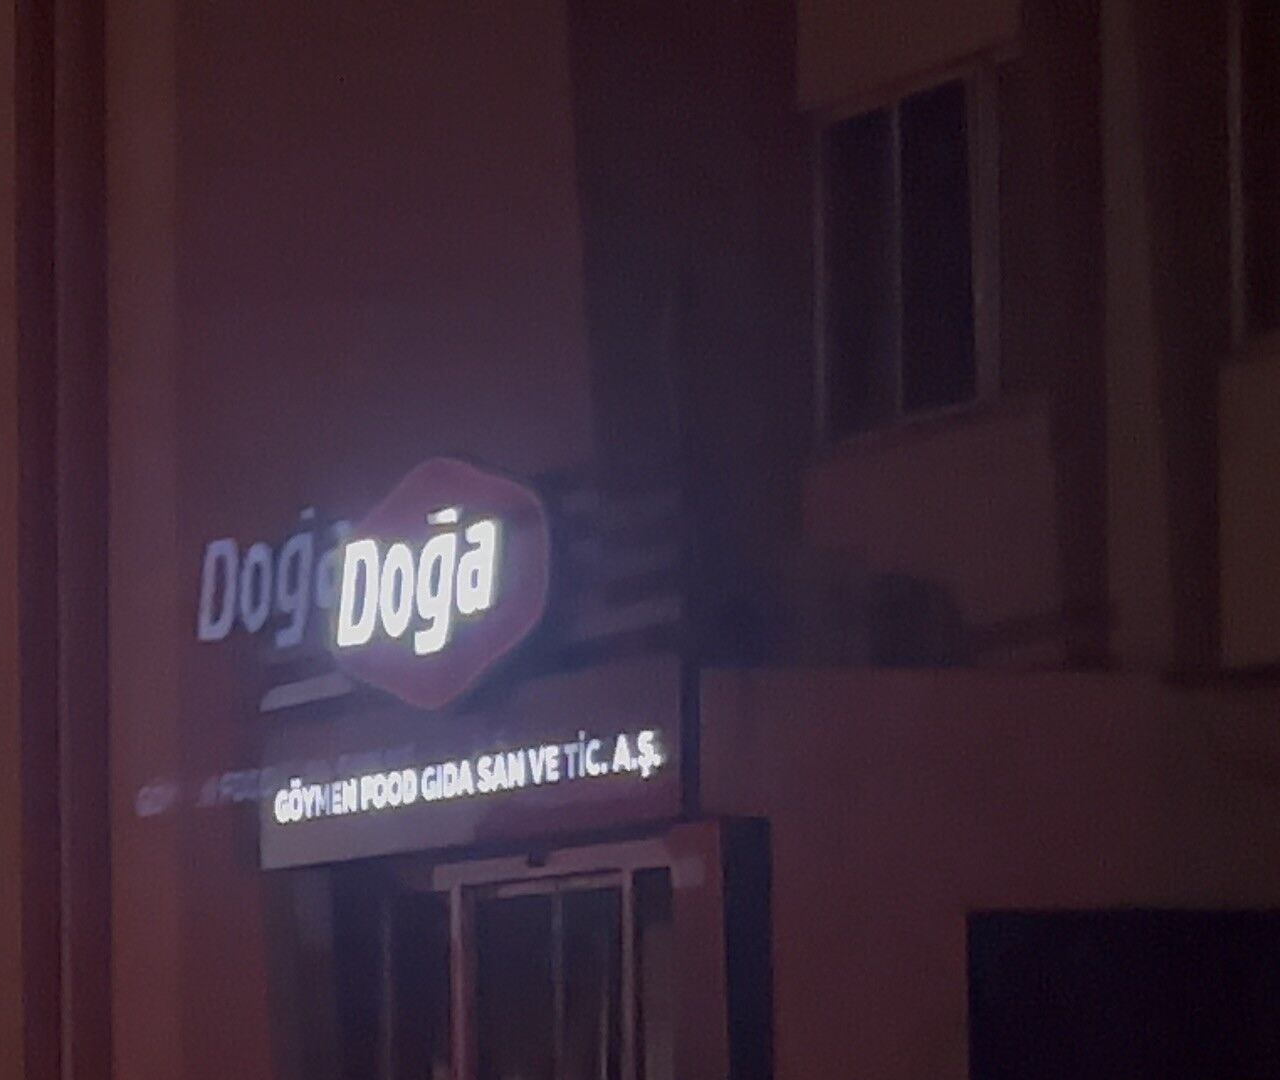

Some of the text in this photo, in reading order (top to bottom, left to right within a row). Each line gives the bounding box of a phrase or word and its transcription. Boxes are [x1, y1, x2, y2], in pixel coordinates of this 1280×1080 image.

[336, 506, 497, 656] Doğa
[274, 776, 358, 825] GÖYMEN
[360, 768, 418, 812] FOOD
[420, 759, 474, 801] GIDA
[477, 751, 526, 793] SAN
[528, 745, 560, 785] VE
[563, 730, 609, 780] TİC.
[612, 729, 662, 778] A.Ş.
